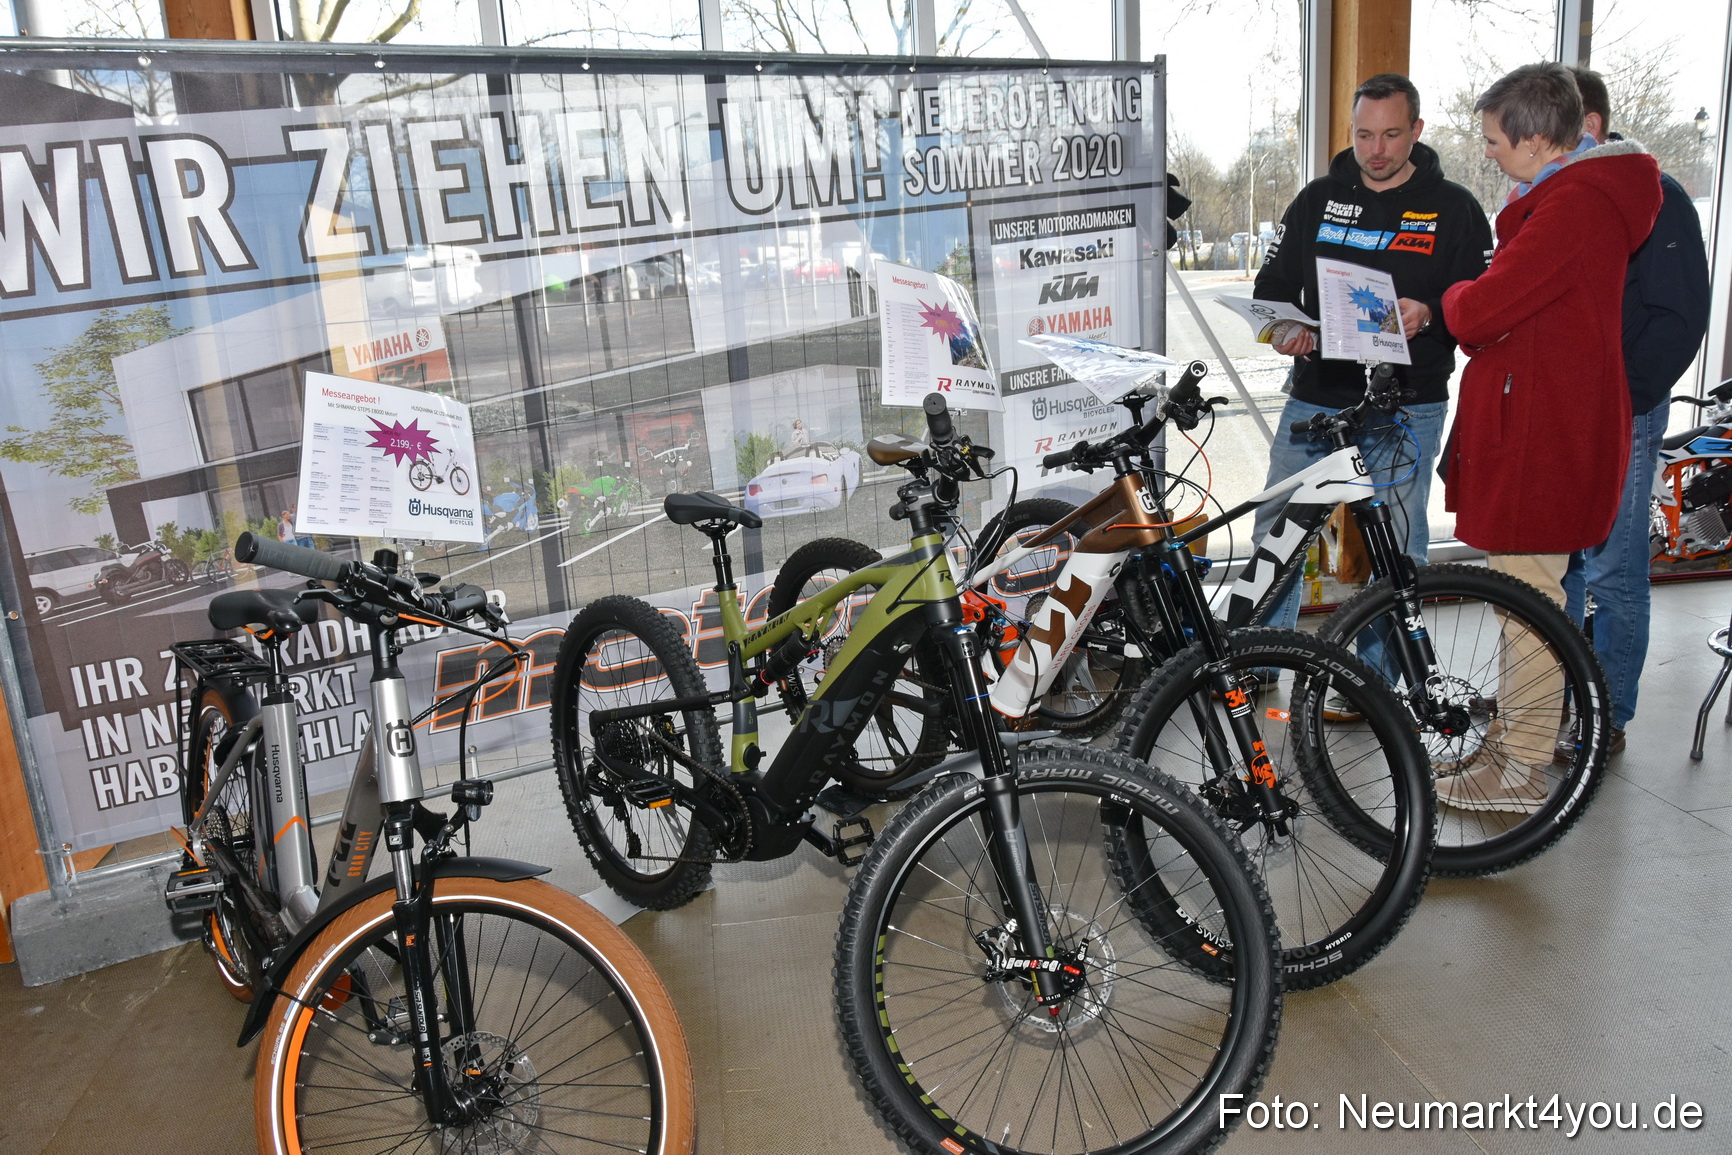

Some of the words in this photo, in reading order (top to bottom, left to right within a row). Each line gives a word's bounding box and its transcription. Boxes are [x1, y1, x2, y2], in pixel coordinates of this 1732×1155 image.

[900, 75, 1143, 138] NEUERÖFFNUNG
[903, 140, 1043, 197] SOMMER
[1051, 132, 1125, 183] 2020
[0, 133, 258, 300] WIR
[281, 102, 692, 264] ZIEHEN
[719, 87, 887, 216] UM!
[994, 219, 1037, 241] UNSERE
[1038, 208, 1133, 236] MOTORRADMARKEN
[1019, 237, 1114, 270] Kawasaki
[1396, 237, 1431, 249] KTM
[892, 275, 926, 290] Messeangebot
[1038, 271, 1100, 305] KTM
[1046, 305, 1113, 335] YAMAHA
[352, 332, 413, 366] YAMAHA
[321, 387, 377, 404] Messeangebot
[955, 378, 996, 392] RAYMON
[1009, 368, 1049, 391] UNSERE
[1083, 406, 1116, 419] BICYCLES
[390, 438, 414, 450] 2.199,-
[417, 442, 422, 450] €
[1057, 421, 1119, 443] RAYMON
[423, 504, 473, 519] Husqvarna
[1249, 572, 1289, 626] OUNTAIN
[1289, 525, 1323, 569] CROSS
[1052, 642, 1073, 670] HARD
[1071, 604, 1097, 640] CROSS
[1405, 614, 1425, 631] 34
[70, 656, 149, 709] IHR
[786, 669, 801, 697] WISS
[1318, 657, 1367, 688] EDDY
[81, 711, 132, 762] IN
[809, 669, 889, 784] RAYMON
[271, 744, 284, 803] Husqvarna
[1018, 767, 1093, 781] MARY
[1554, 752, 1595, 825] NOBBY
[1591, 713, 1602, 750] NIC
[555, 738, 576, 808] NOBBY
[573, 813, 590, 840] NIC
[1100, 773, 1180, 816] MAGIC
[354, 831, 374, 852] CITY
[347, 854, 366, 877] GRAN
[1010, 844, 1023, 877] durolux
[1176, 906, 1195, 926] DT
[296, 981, 306, 995] BIG
[304, 957, 322, 981] APPLE
